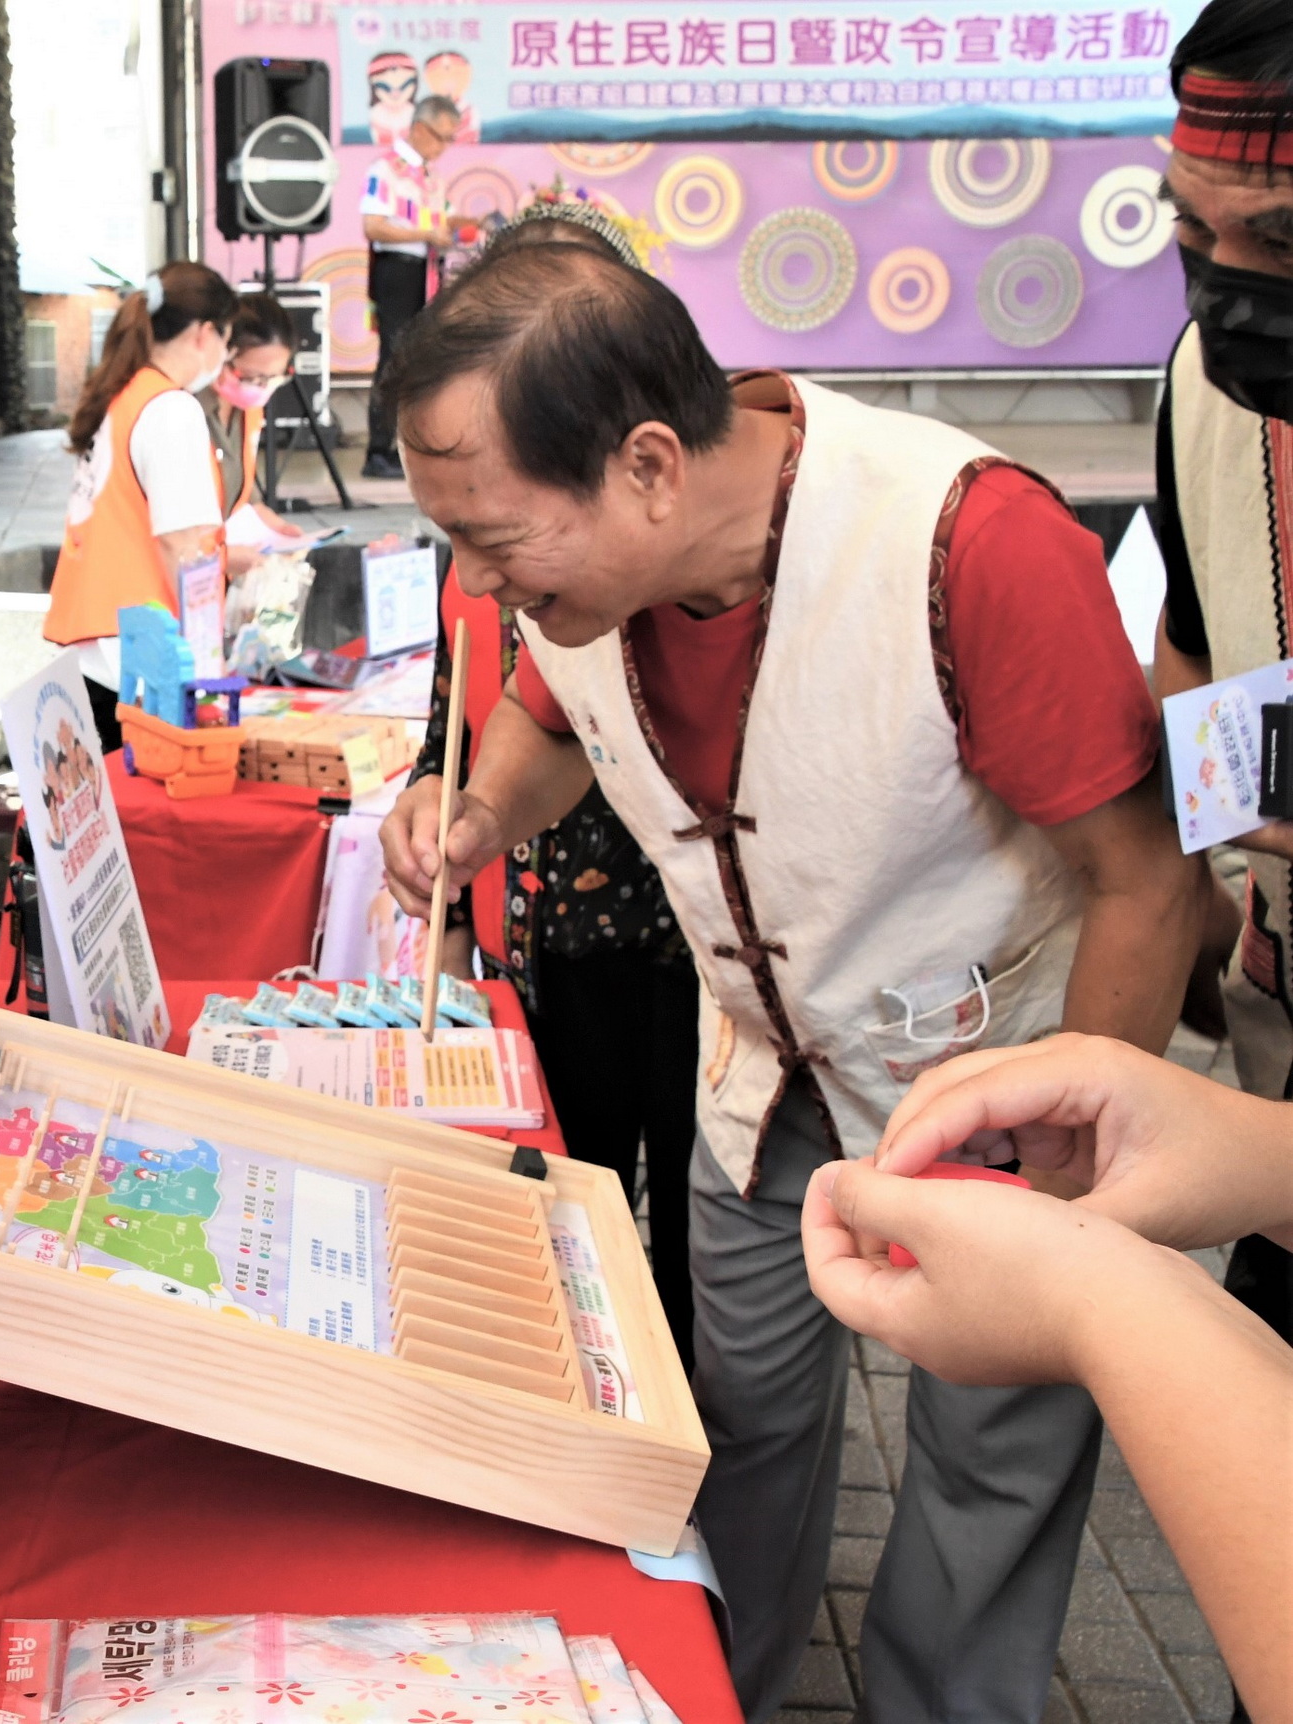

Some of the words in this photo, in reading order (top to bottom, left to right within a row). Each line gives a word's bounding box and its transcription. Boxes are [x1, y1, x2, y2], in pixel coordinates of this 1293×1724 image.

[510, 11, 1170, 66] 原住民族日暨政令宣導活動
[6, 1636, 38, 1683] 클리닝
